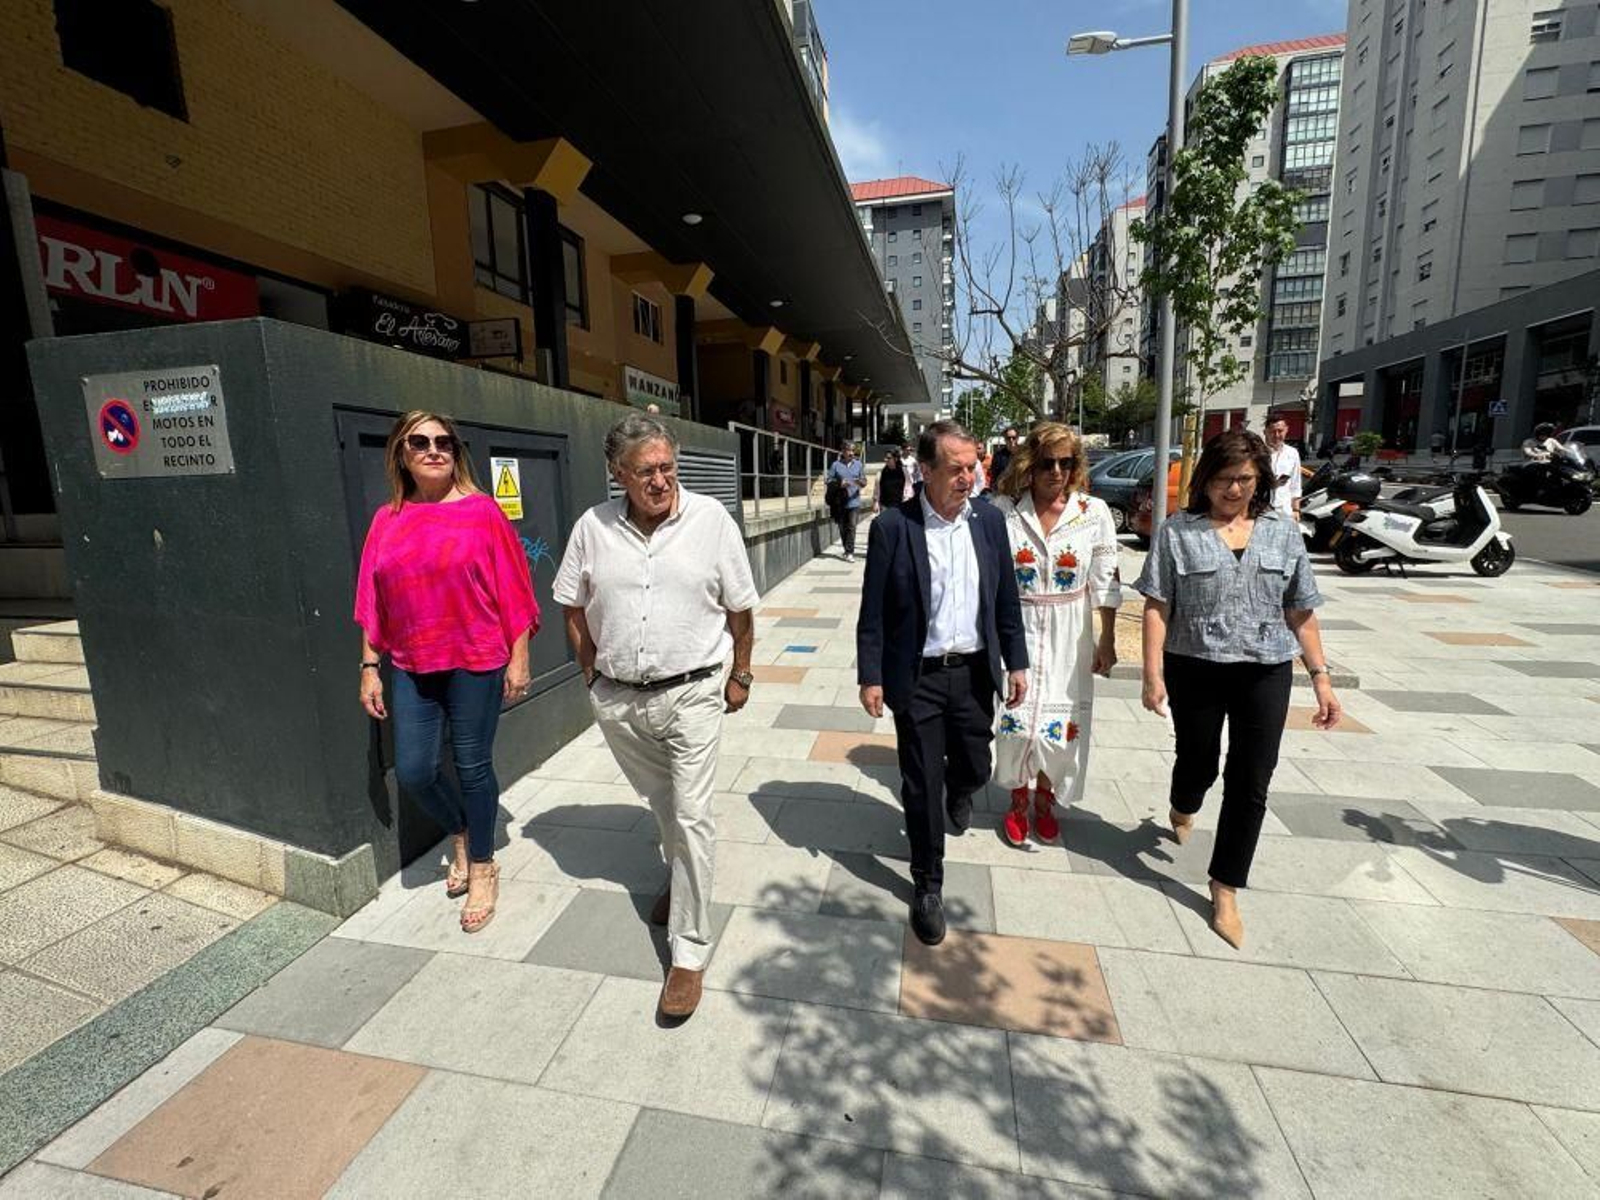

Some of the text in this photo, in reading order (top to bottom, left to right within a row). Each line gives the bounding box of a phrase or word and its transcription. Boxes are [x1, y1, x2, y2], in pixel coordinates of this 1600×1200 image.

[374, 311, 396, 337] El
[143, 375, 211, 393] PROHIBIDO
[152, 415, 214, 431] MOTOS EN
[161, 434, 212, 449] TODO EL
[163, 453, 215, 467] RECINTO
